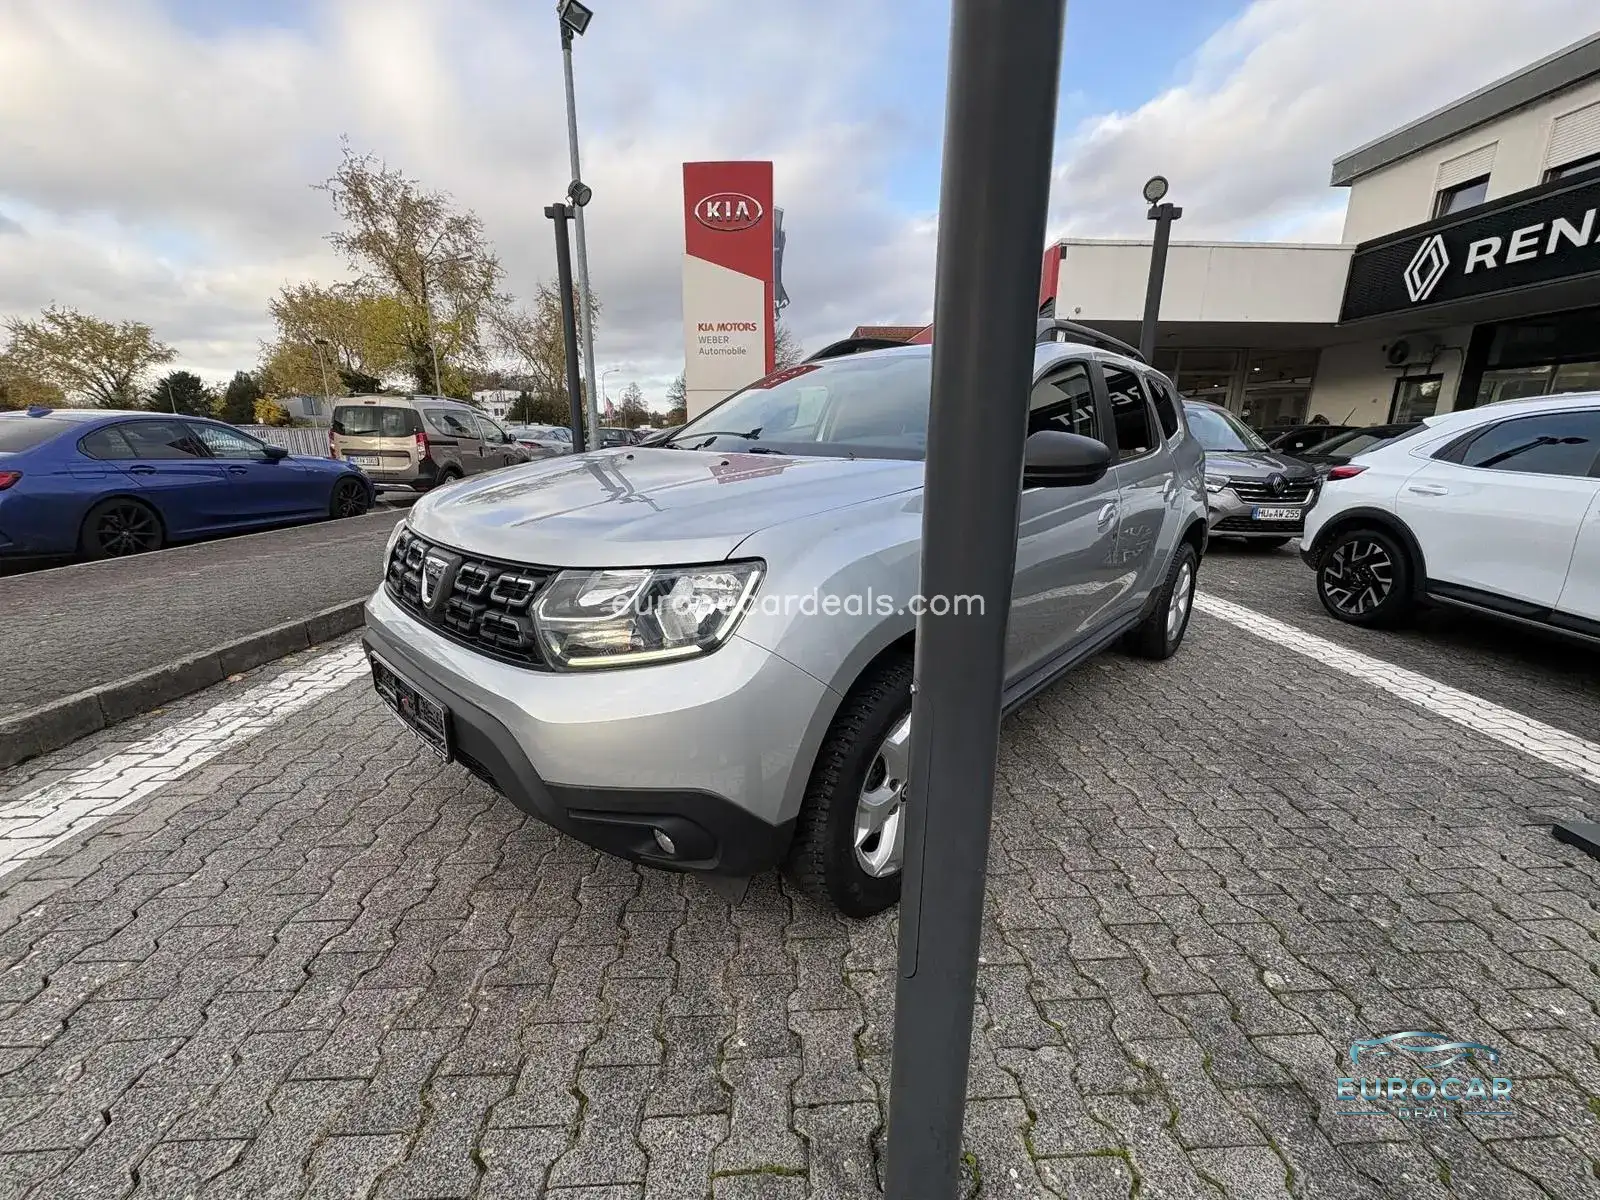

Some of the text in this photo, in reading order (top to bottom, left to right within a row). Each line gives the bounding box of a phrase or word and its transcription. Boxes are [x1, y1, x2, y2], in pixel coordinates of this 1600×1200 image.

[707, 200, 751, 221] KIA
[697, 322, 757, 332] KIA MOTORS
[698, 335, 730, 344] WEBER
[698, 346, 747, 356] Automobile
[1285, 509, 1300, 519] 255
